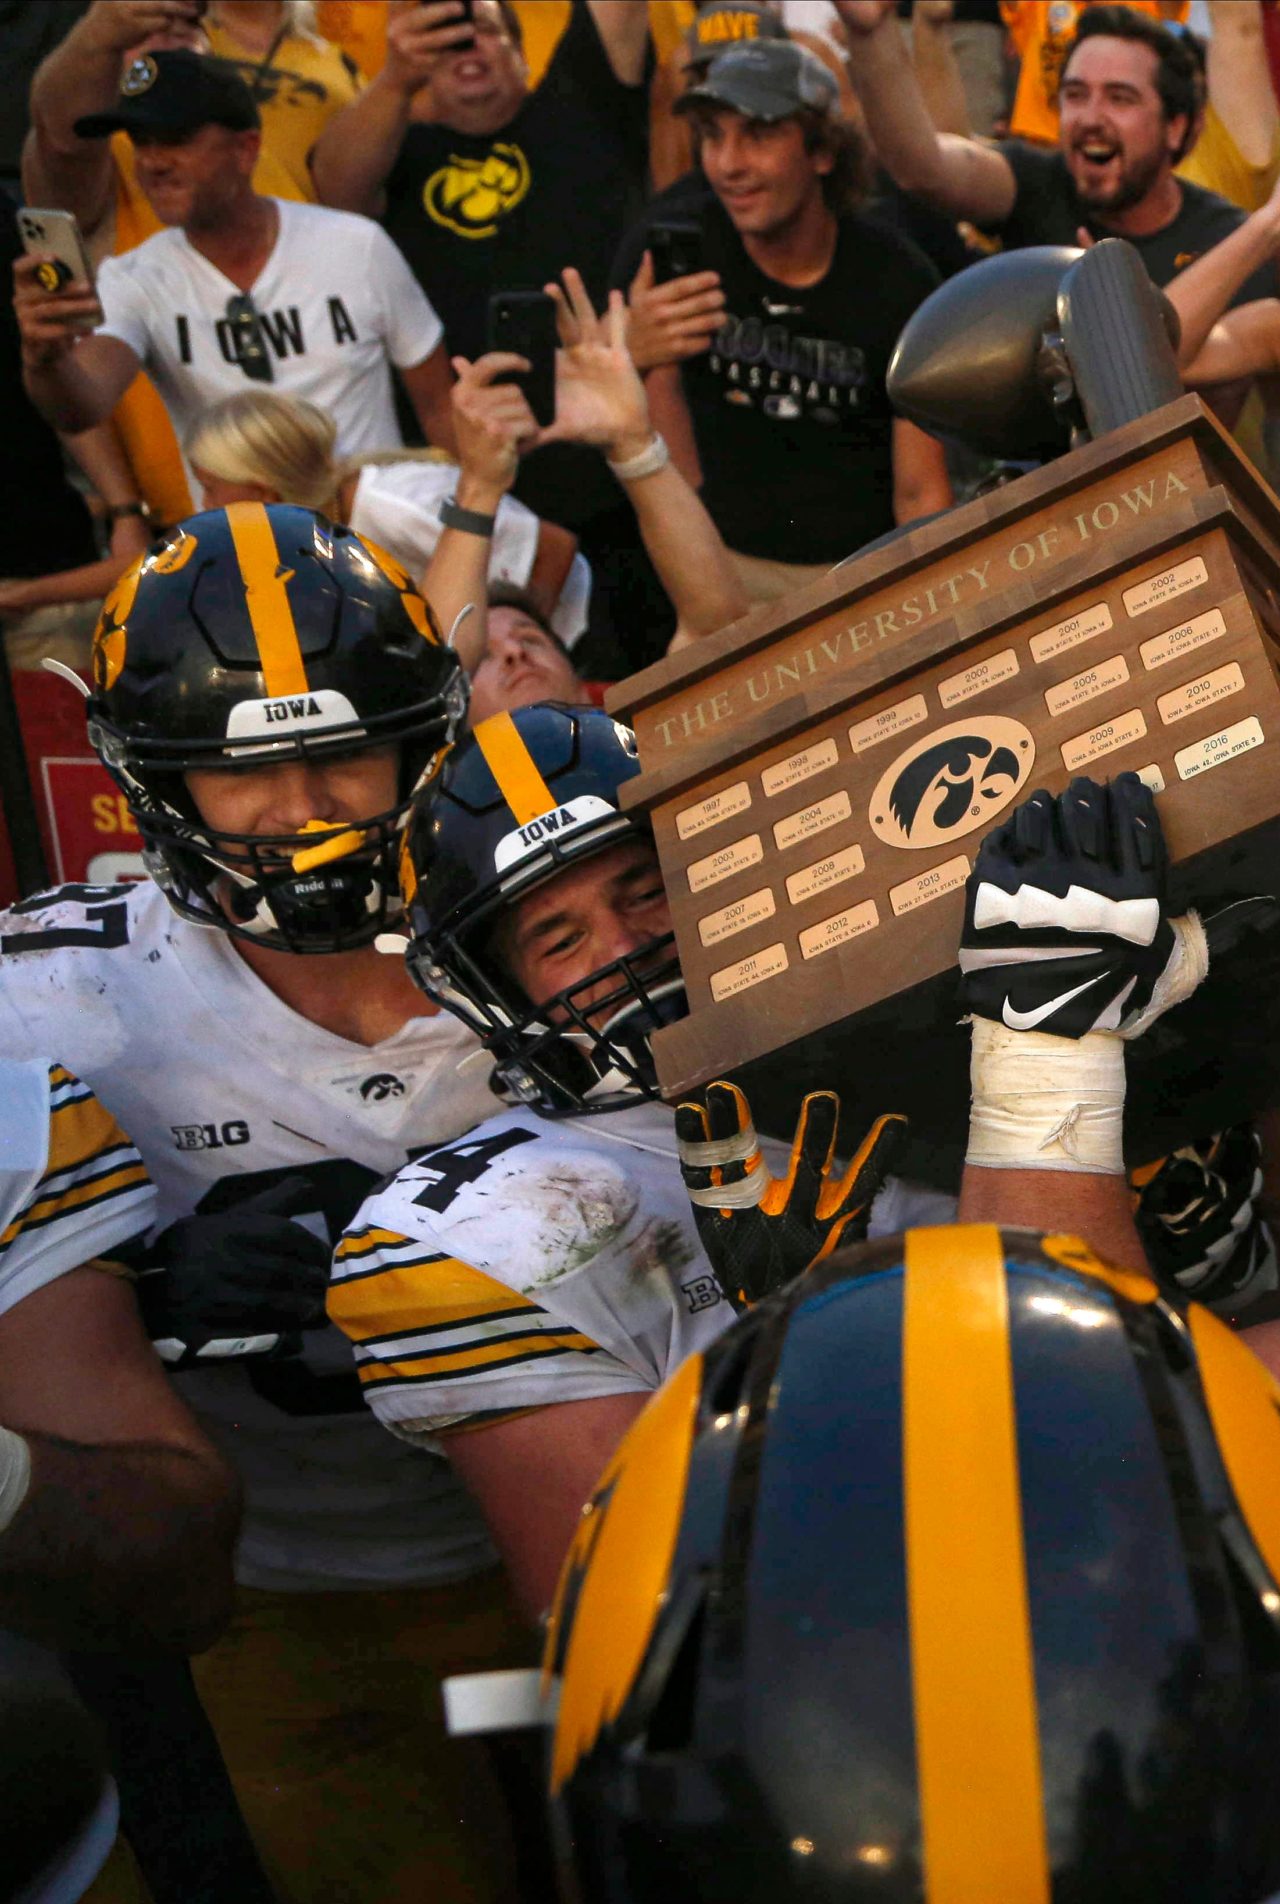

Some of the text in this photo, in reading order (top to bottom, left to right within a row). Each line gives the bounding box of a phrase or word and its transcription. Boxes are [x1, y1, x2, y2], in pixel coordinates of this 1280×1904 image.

[176, 295, 358, 365] IOWA
[1150, 572, 1175, 591] 2002
[655, 471, 1189, 747] THE UNIVERSITY OF IOWA
[1058, 619, 1080, 636] 2001
[1168, 626, 1193, 644] 2006
[964, 665, 988, 683] 2000
[1073, 672, 1097, 690] 2005
[1185, 679, 1211, 698] 2010
[263, 697, 322, 722] IOWA
[1167, 707, 1182, 719] IOWA
[1194, 694, 1210, 705] IOWA
[1212, 685, 1229, 697] STATE
[876, 710, 896, 726] 1999
[1089, 726, 1114, 744] 2009
[1203, 734, 1228, 752] 2016
[1071, 753, 1086, 764] IOWA
[1097, 740, 1112, 751] IOWA
[1114, 731, 1132, 743] STATE
[788, 755, 808, 770] 1998
[1184, 763, 1200, 775] IOWA
[1213, 749, 1229, 761] IOWA
[1231, 740, 1249, 753] STATE
[702, 798, 721, 813] 1997
[799, 807, 822, 824] 2004
[518, 808, 577, 847] IOWA
[712, 850, 735, 867] 2003
[812, 860, 835, 878] 2008
[917, 872, 940, 890] 2013
[897, 900, 912, 911] IOWA
[923, 887, 938, 899] IOWA
[940, 878, 957, 891] STATE
[724, 903, 746, 920] 2007
[826, 917, 848, 934] 2012
[808, 942, 823, 953] IOWA
[738, 960, 757, 975] 2011
